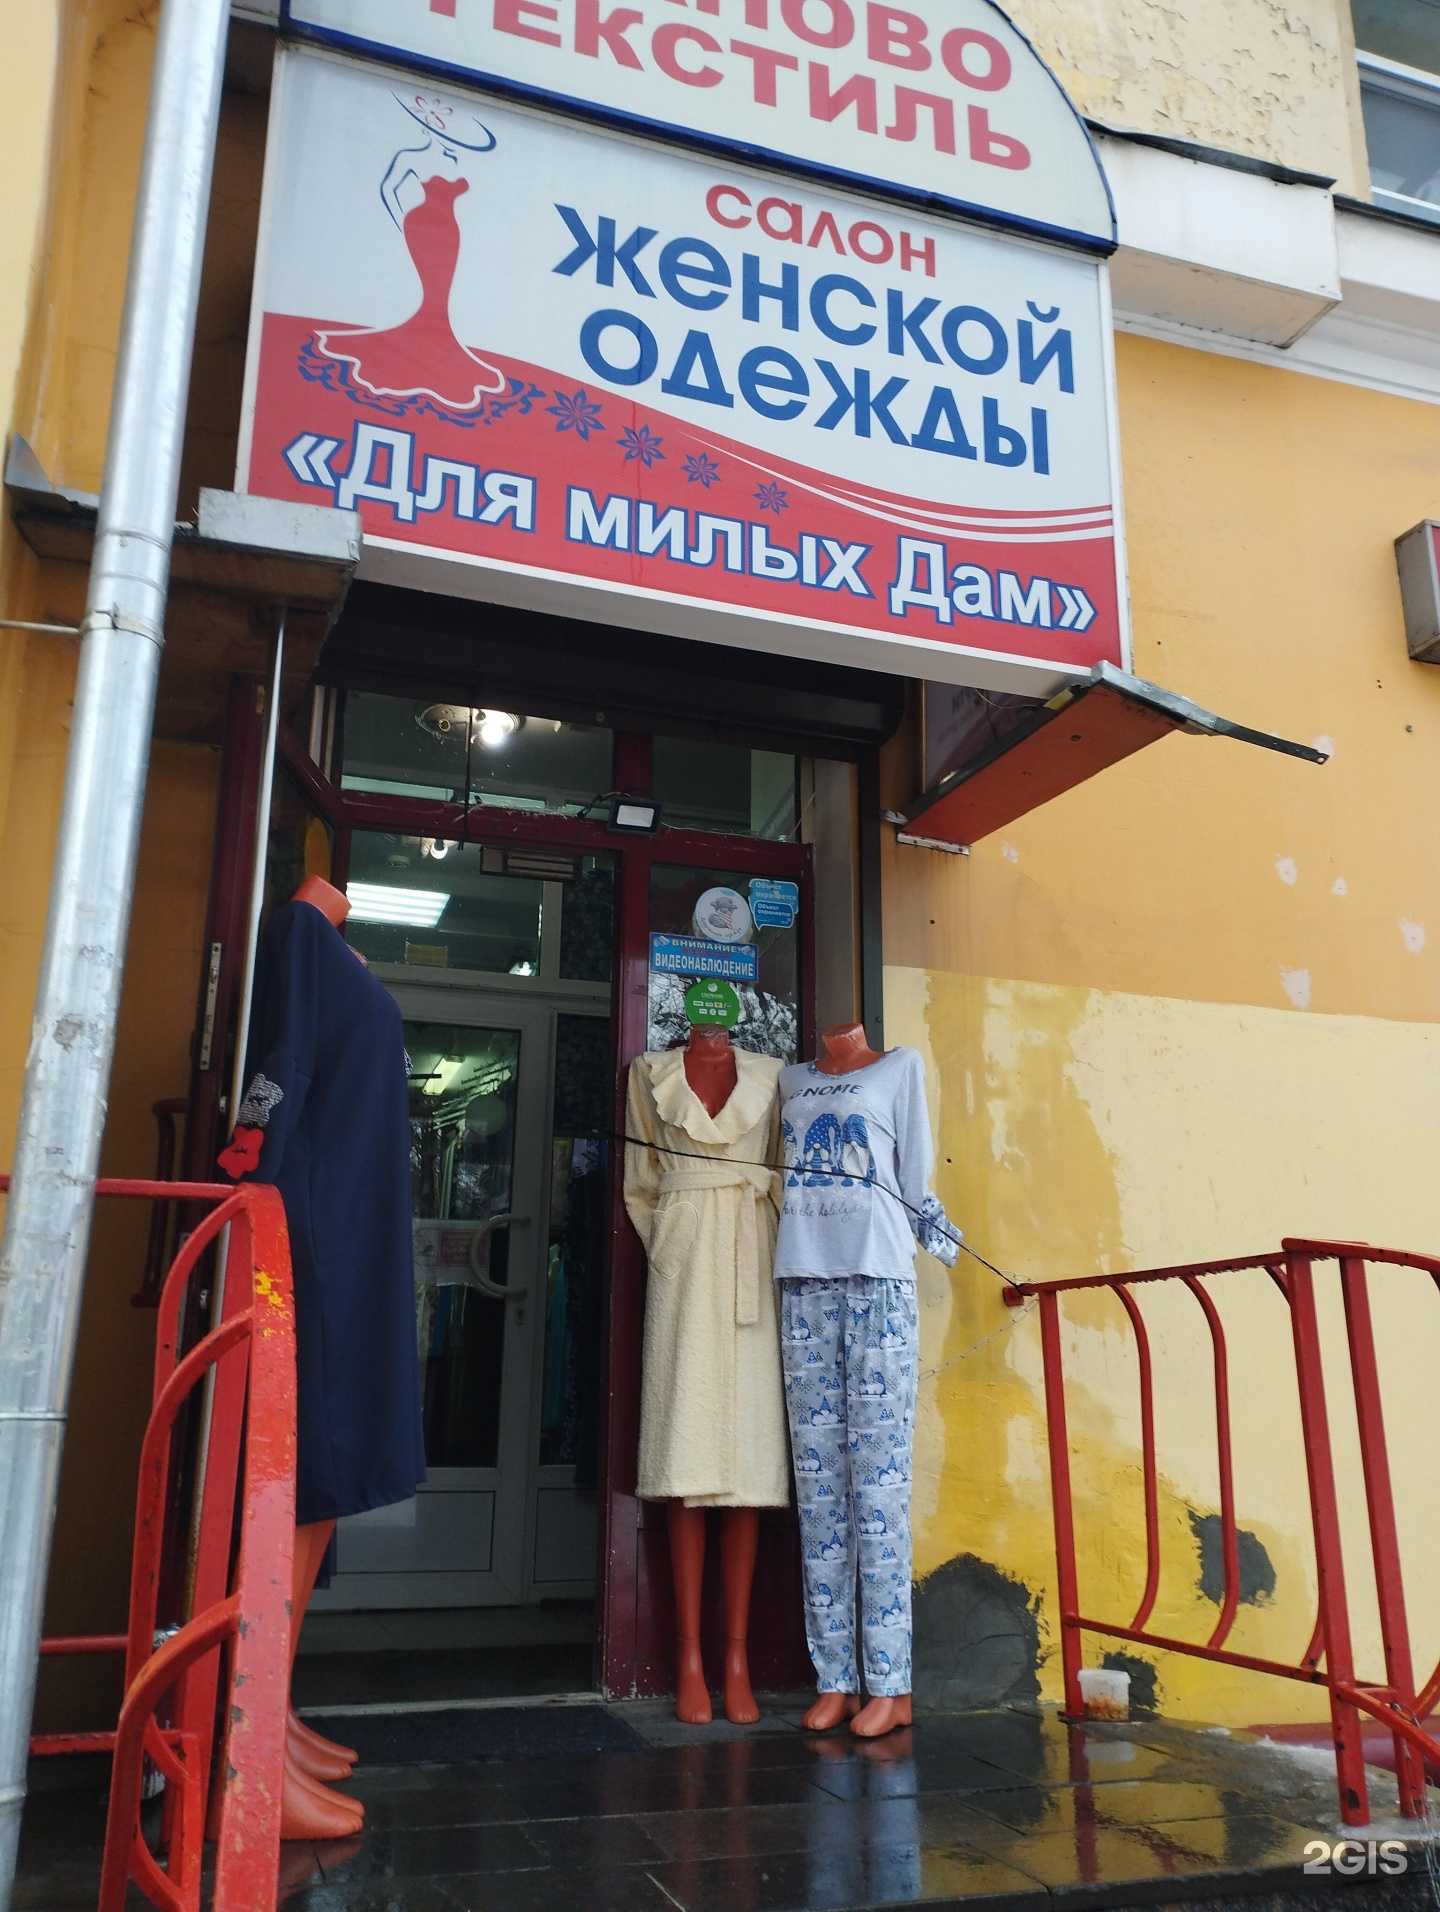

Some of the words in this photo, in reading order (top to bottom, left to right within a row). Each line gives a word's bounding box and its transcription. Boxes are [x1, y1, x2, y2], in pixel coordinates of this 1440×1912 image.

[705, 184, 936, 278] салон
[282, 420, 537, 534] «Для
[566, 485, 877, 600] милых
[888, 535, 1099, 634] Дам»
[655, 953, 754, 977] ВИДЕОНАБЛЮДЕНИЕ
